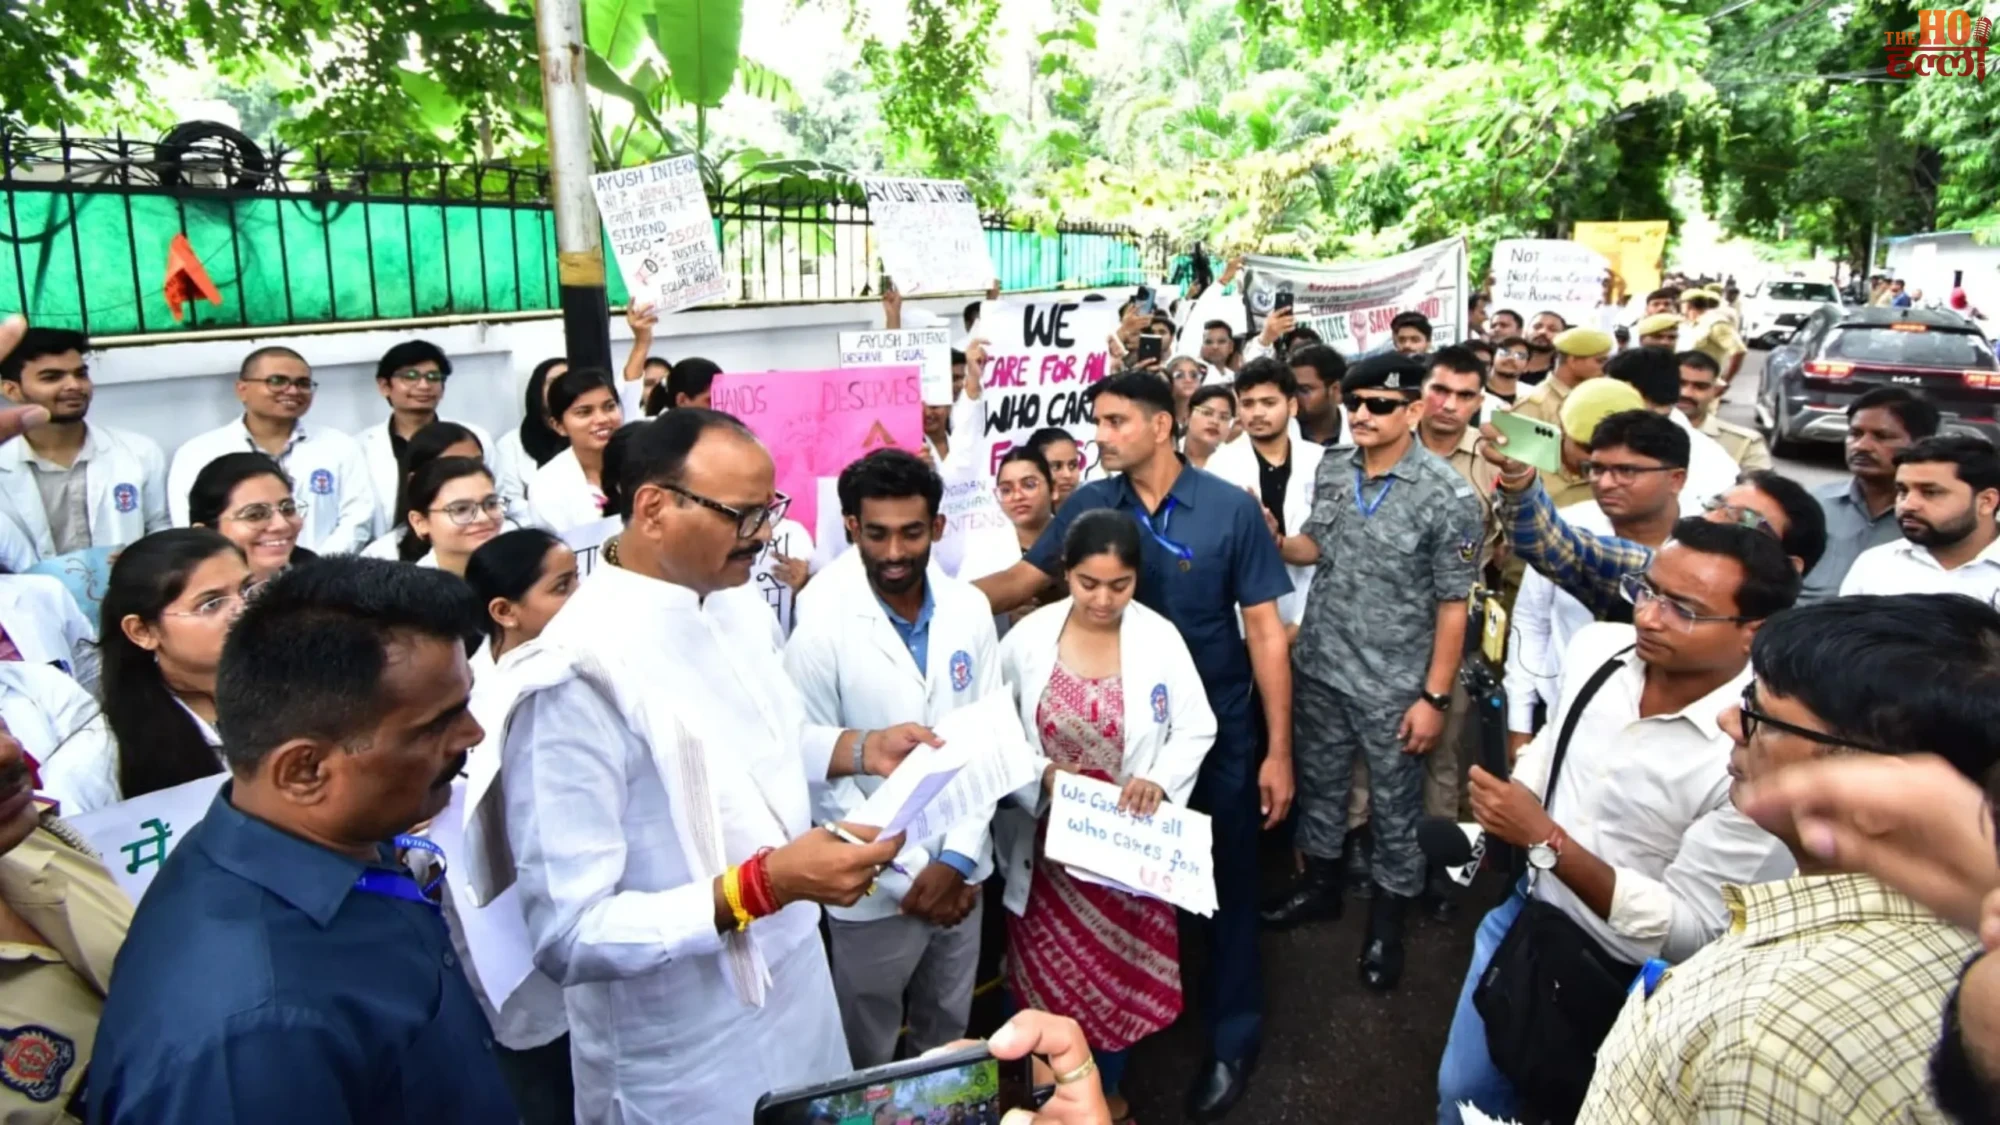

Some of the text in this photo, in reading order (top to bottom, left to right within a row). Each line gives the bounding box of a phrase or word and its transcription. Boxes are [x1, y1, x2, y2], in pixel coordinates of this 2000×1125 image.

[596, 172, 644, 191] AYUSH
[864, 181, 925, 203] AYUSH
[611, 220, 667, 242] STIPEND
[616, 222, 712, 255] 7500 25000
[671, 240, 707, 260] JUSTICE
[660, 277, 692, 295] EQUAL
[1023, 303, 1080, 348] WE
[1317, 317, 1348, 342] STATE
[857, 333, 901, 349] AYUSH
[895, 349, 928, 362] EQUAL
[1039, 354, 1077, 385] FOR
[713, 385, 767, 415] HANDS
[983, 393, 1041, 438] WHO
[1161, 817, 1183, 838] all
[1067, 817, 1107, 840] who
[1169, 849, 1200, 876] for
